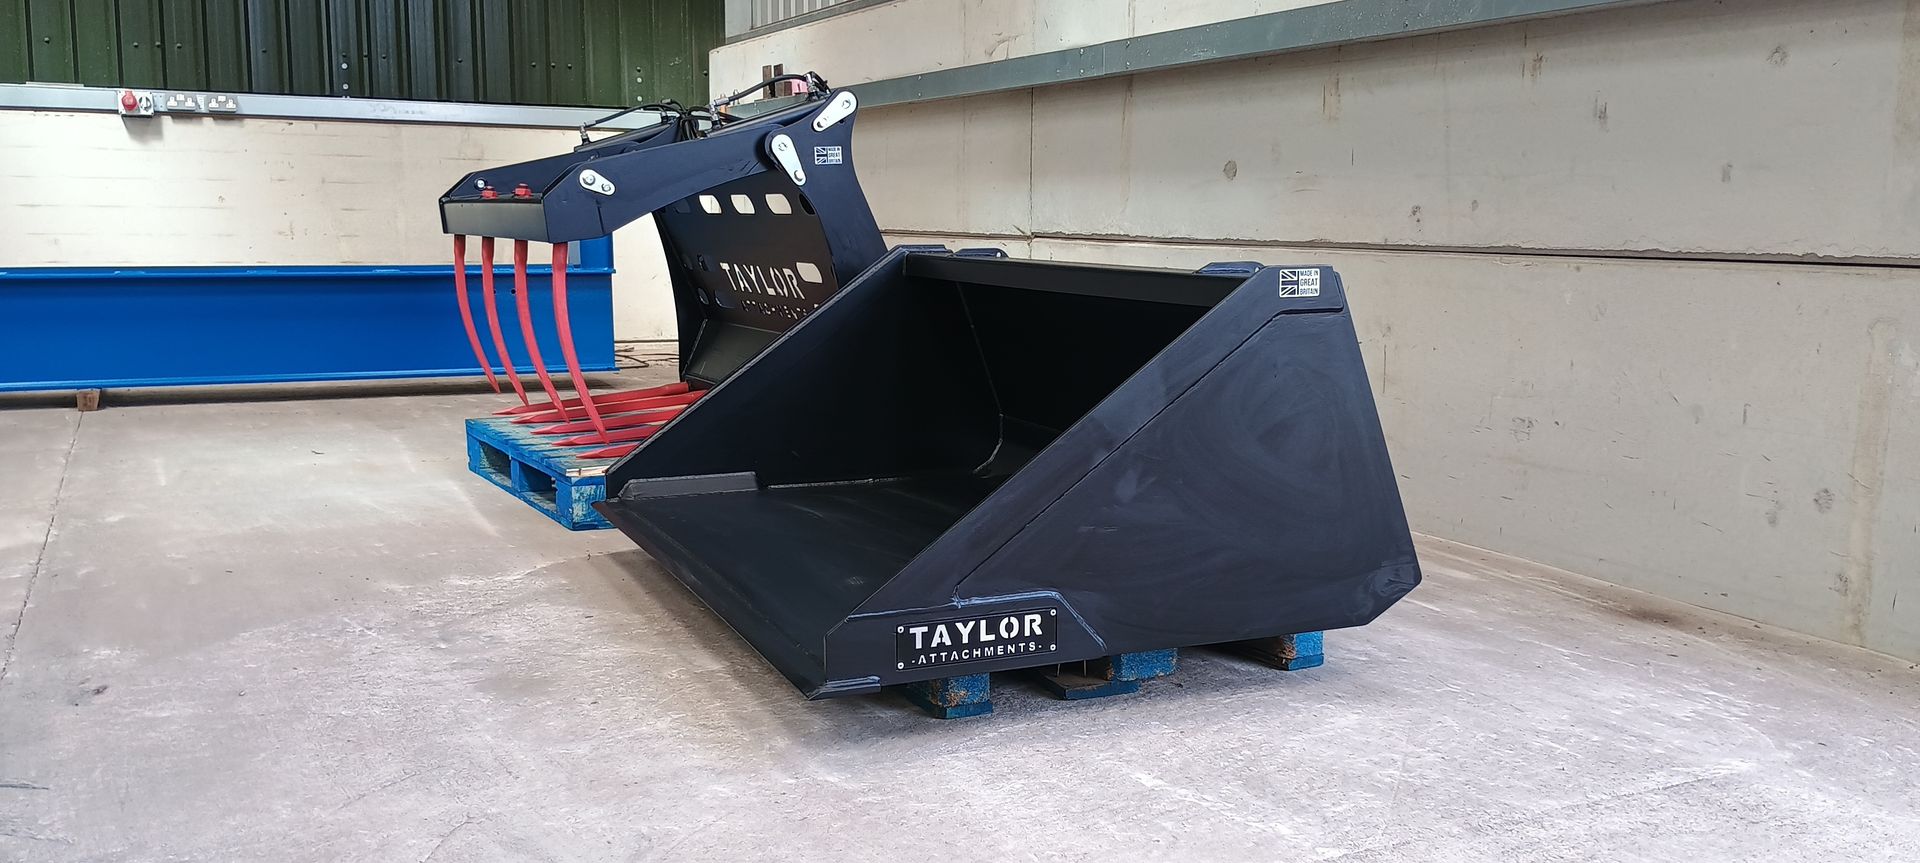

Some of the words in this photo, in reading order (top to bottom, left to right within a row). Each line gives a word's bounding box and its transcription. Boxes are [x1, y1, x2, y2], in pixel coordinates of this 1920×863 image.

[719, 262, 805, 300] TAYLOR
[1300, 278, 1318, 286] GREAT
[909, 613, 1043, 649] TAYLOR
